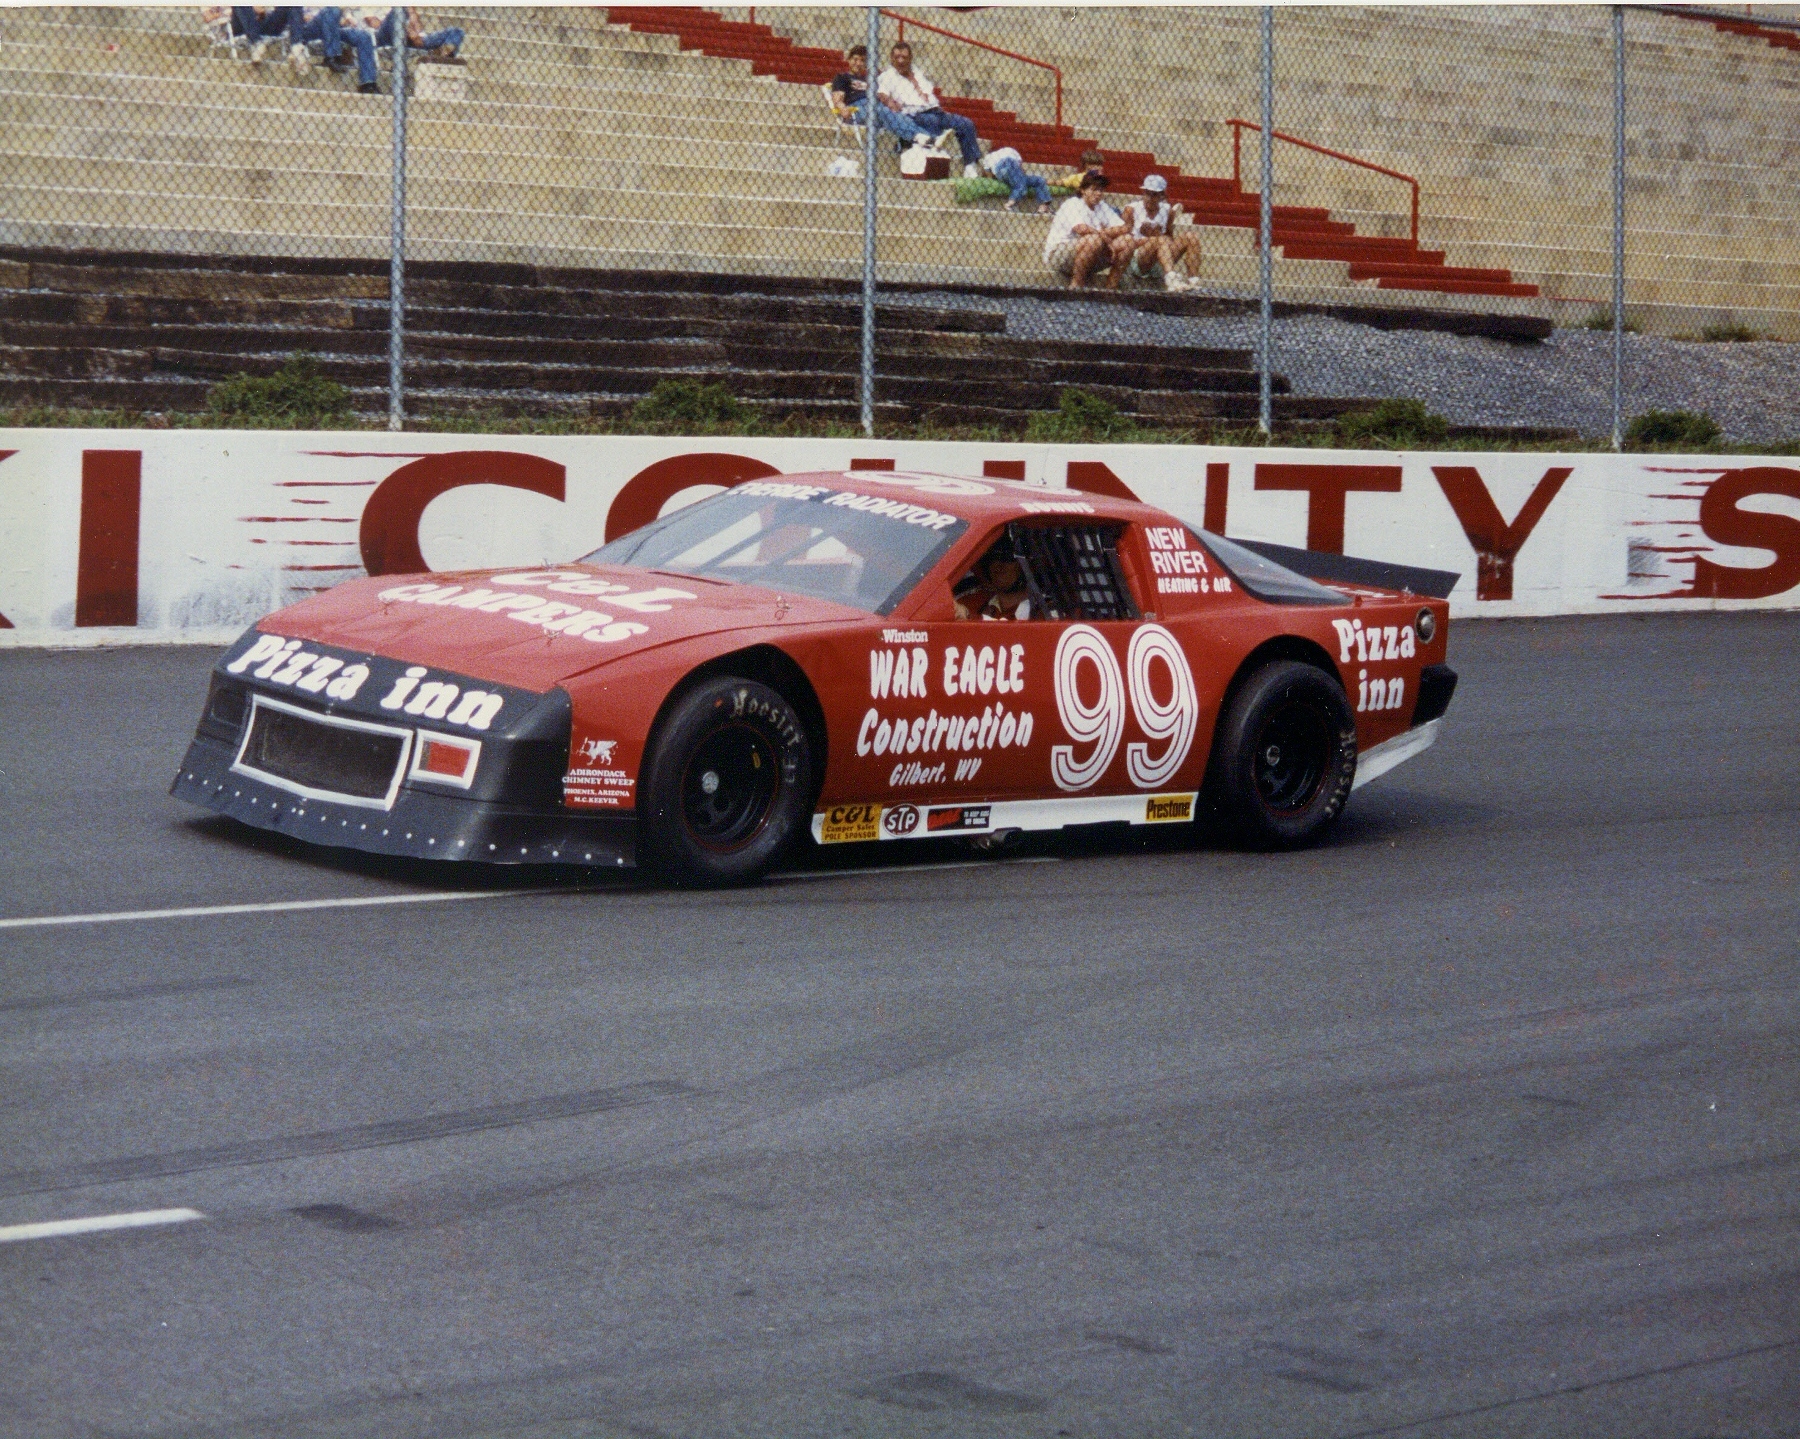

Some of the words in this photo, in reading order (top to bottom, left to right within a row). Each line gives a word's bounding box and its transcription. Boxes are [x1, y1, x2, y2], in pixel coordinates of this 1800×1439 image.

[822, 492, 957, 530] RADIATOR
[359, 450, 1574, 601] CTY
[1144, 527, 1187, 550] NEW
[1150, 550, 1208, 574] RIVER
[1157, 577, 1198, 593] HEATING
[1213, 576, 1232, 593] AIR
[377, 583, 650, 643] CAMPERS
[882, 628, 929, 643] Winston
[1331, 618, 1416, 664] Pizza
[226, 633, 370, 701] Pizza
[379, 666, 504, 731] inn
[870, 647, 929, 700] WAR
[943, 643, 1025, 697] EAGLE
[1356, 668, 1405, 712] inn
[1050, 623, 1199, 792] 99
[856, 701, 1034, 758] Construction
[570, 769, 626, 777] ADIRONDACK
[603, 778, 635, 786] SWEEP
[889, 761, 947, 787] Gilbert,
[954, 757, 982, 782] WV
[597, 789, 630, 797] ARIZONA
[887, 807, 916, 831] STP
[1146, 798, 1191, 819] Prestone
[844, 831, 877, 840] SPONSOR
